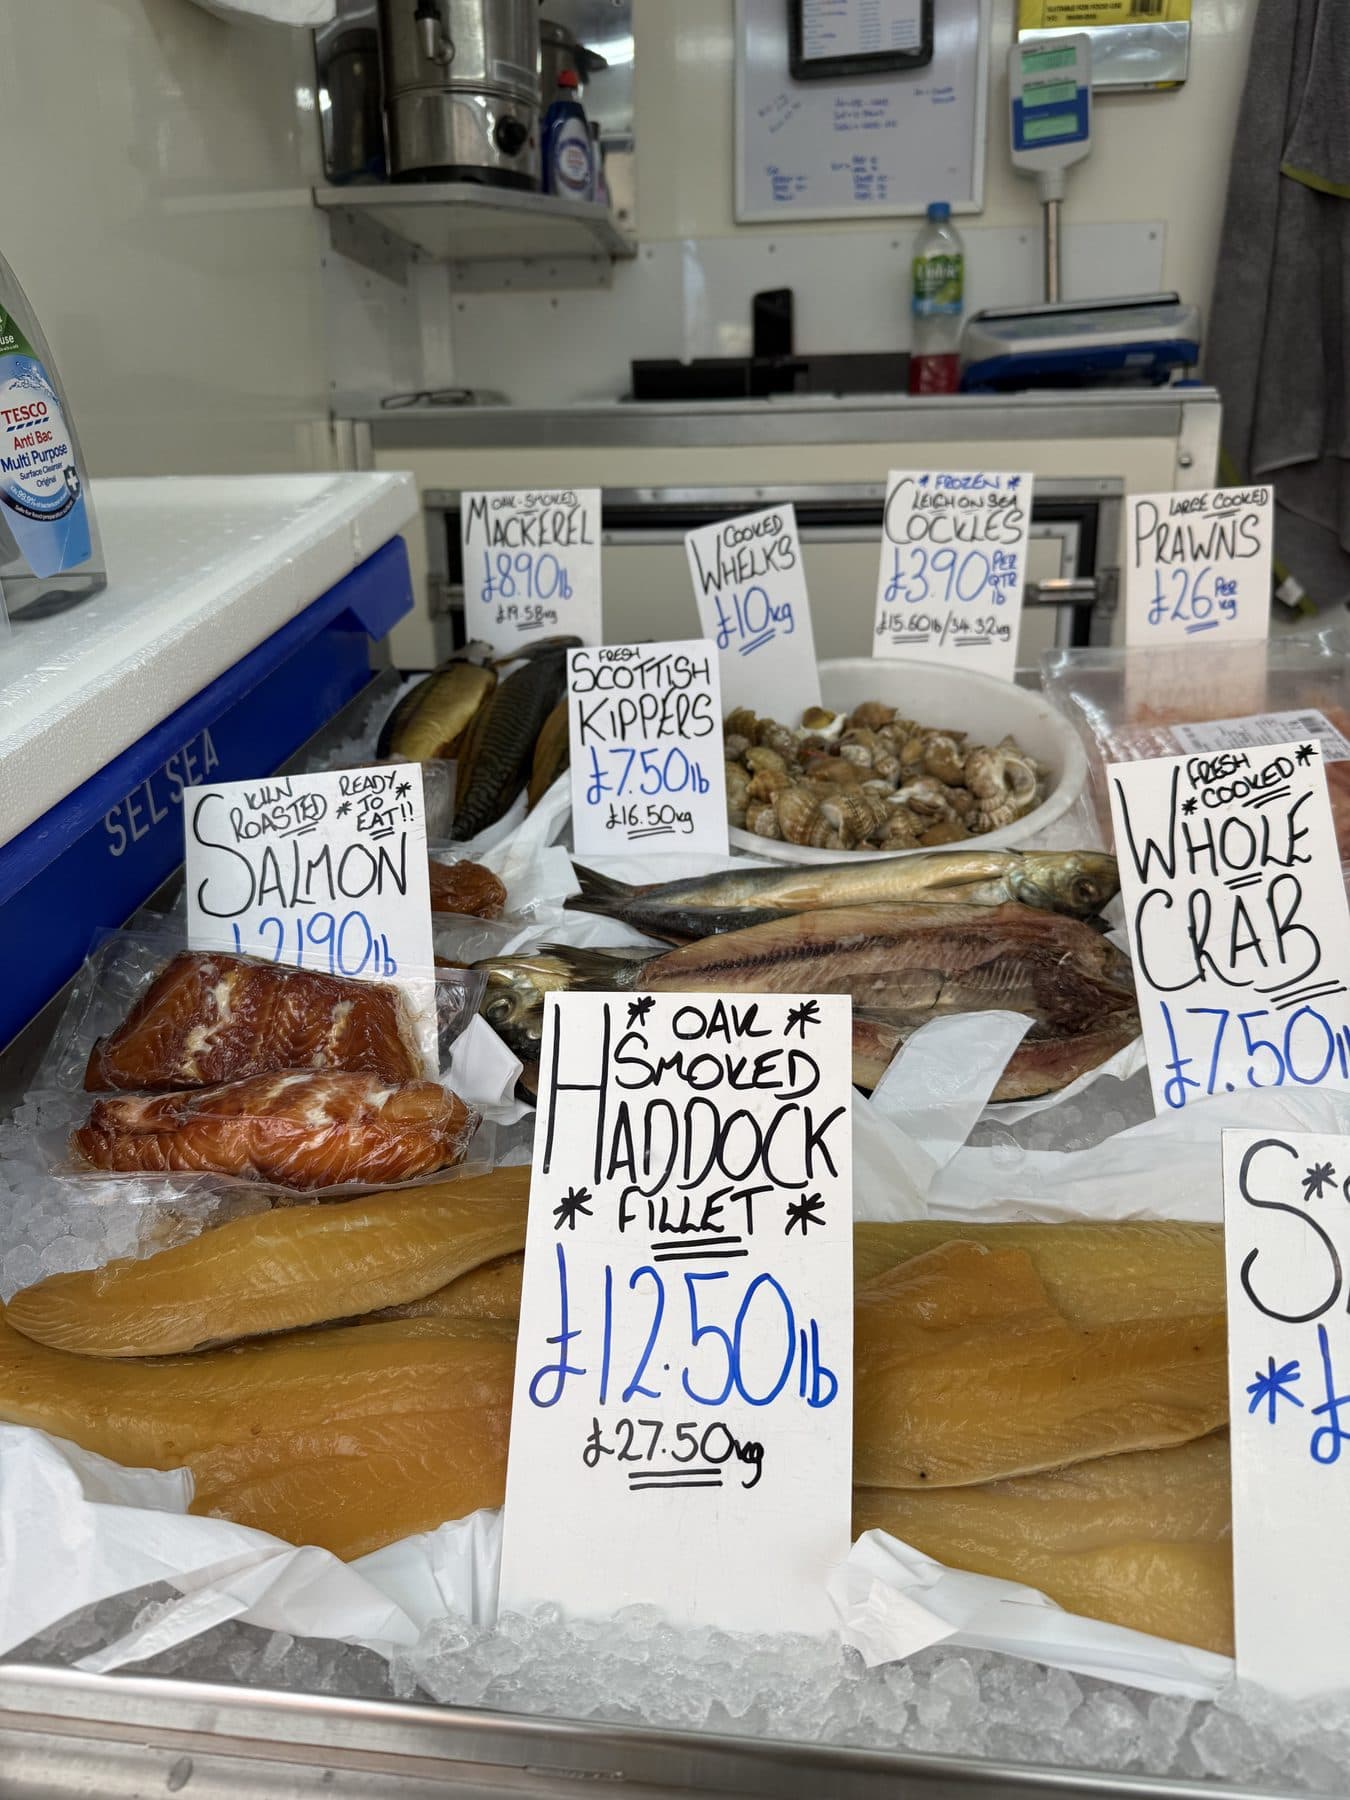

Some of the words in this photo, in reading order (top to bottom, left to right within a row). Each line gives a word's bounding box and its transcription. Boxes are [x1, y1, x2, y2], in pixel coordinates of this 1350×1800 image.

[1, 401, 47, 425] TESCO
[0, 452, 31, 473] Multi
[31, 443, 68, 464] Purpose
[14, 433, 35, 451] Anti
[35, 430, 53, 446] Bac
[19, 467, 43, 481] Surface
[934, 473, 1001, 490] FROZEN
[884, 478, 1024, 544] COCKLES
[911, 491, 955, 511] LEIGH
[957, 496, 985, 508] ON
[987, 491, 1019, 511] SEA
[1168, 494, 1208, 516] LARGE
[1213, 488, 1269, 509] COOKED
[466, 495, 595, 548] MACKEREL
[723, 515, 783, 547] COOKED
[1135, 501, 1261, 568] PRAWNS
[691, 534, 796, 595] WHELKS
[992, 550, 1017, 570] PER
[988, 572, 1016, 591] QTR
[992, 589, 1007, 606] lb
[1148, 566, 1213, 625] £26
[1215, 577, 1237, 597] PER
[1218, 600, 1237, 620] kg
[572, 652, 710, 692] SCOTTISH
[599, 647, 640, 663] FRESH
[578, 687, 714, 746] KIPPERS
[339, 771, 397, 797] READY
[1187, 753, 1251, 789] FRESH
[1201, 757, 1294, 808] COOKED
[244, 777, 292, 810] KILN
[357, 796, 384, 812] TO
[230, 793, 328, 843] ROASTED
[1114, 765, 1314, 884] WHOLE
[193, 793, 407, 918] SALMON
[1135, 873, 1321, 993] CRAB
[672, 999, 772, 1043] OAK
[614, 1031, 820, 1100] SMOKED
[1160, 1000, 1350, 1109] £7.50l
[543, 1003, 847, 1197] HADDOCK
[619, 1185, 775, 1235] FILLET
